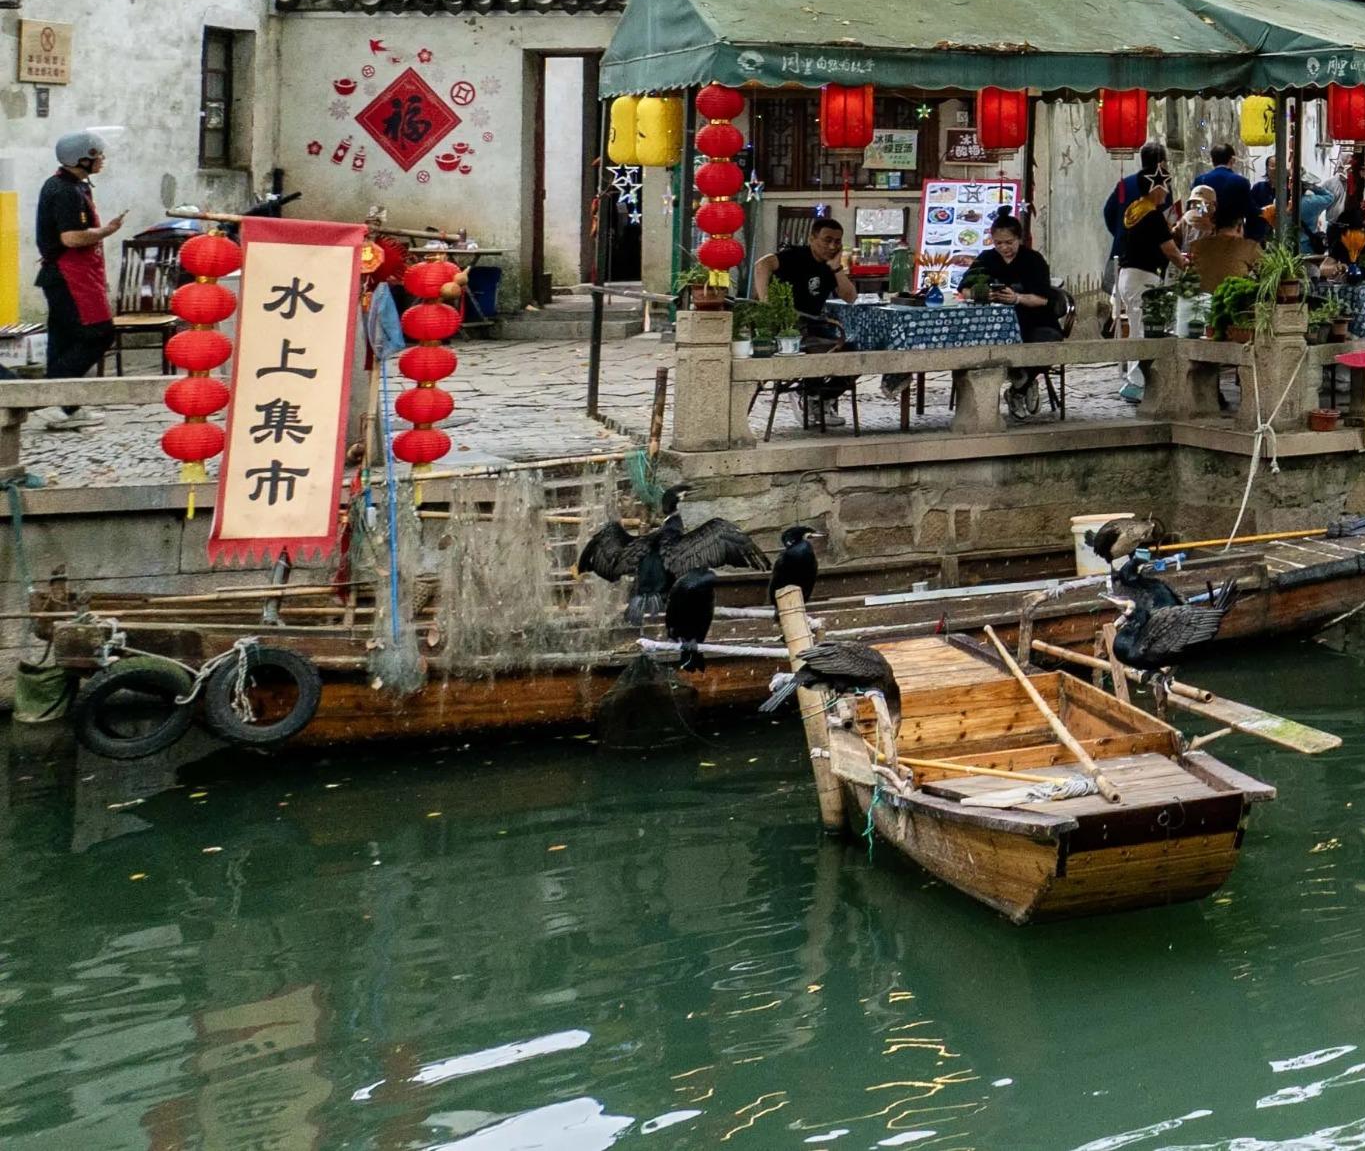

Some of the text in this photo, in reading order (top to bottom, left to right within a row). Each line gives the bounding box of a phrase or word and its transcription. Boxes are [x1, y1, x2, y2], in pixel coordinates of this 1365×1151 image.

[382, 94, 433, 148] 福
[245, 277, 325, 507] 水上集市
